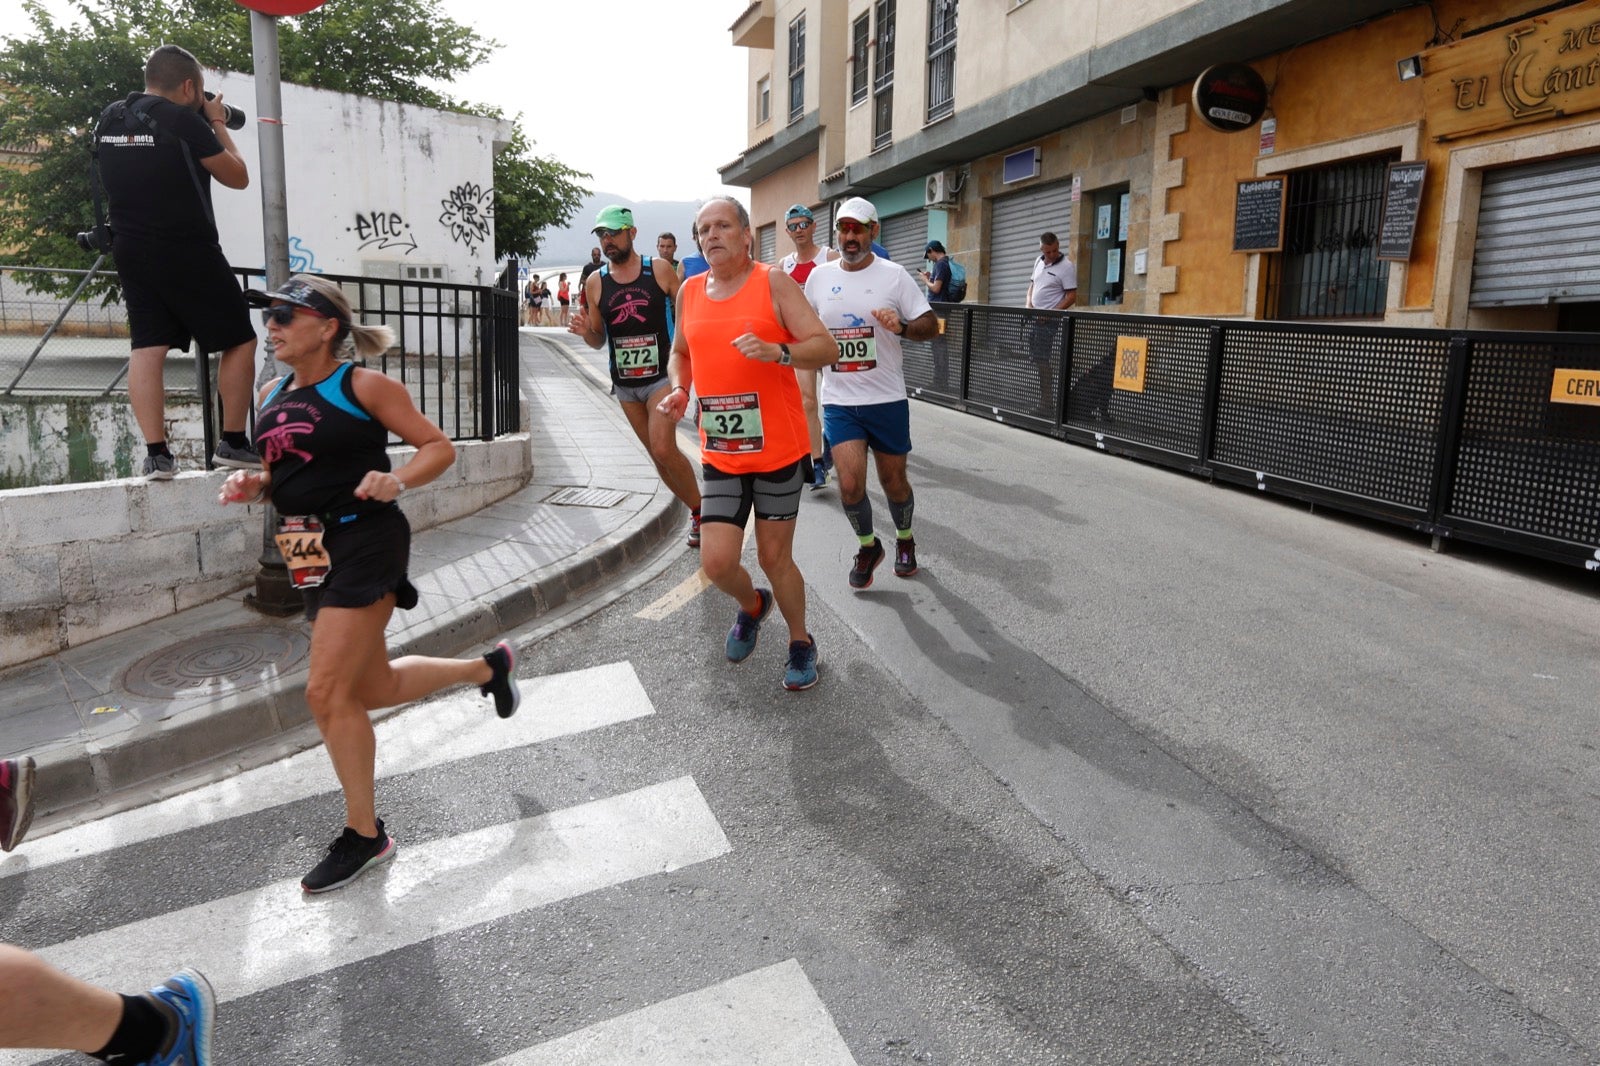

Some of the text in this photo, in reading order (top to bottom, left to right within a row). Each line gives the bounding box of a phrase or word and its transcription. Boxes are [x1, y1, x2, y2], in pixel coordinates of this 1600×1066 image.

[1455, 77, 1488, 110] El
[622, 349, 653, 365] 272
[714, 413, 745, 434] 32
